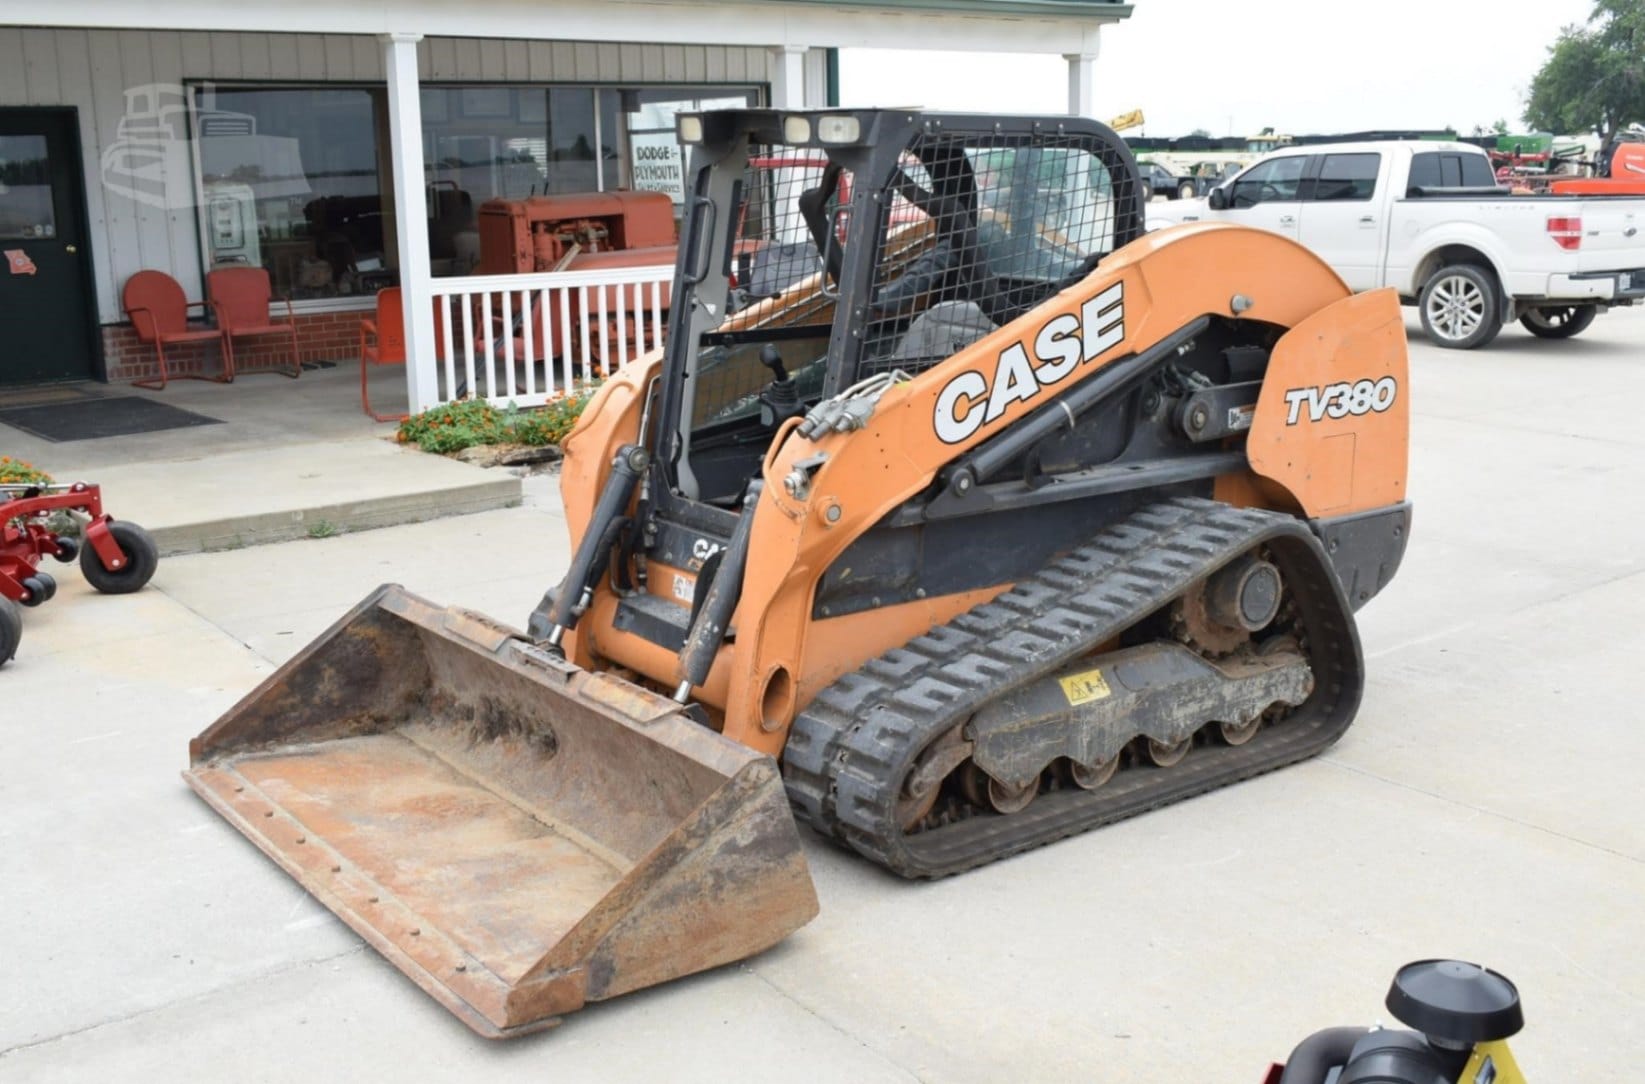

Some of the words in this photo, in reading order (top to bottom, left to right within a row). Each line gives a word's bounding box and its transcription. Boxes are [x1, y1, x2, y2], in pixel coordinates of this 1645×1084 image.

[635, 165, 680, 180] PLYMOUTH
[933, 280, 1125, 445] CASE
[1285, 375, 1397, 426] TV380
